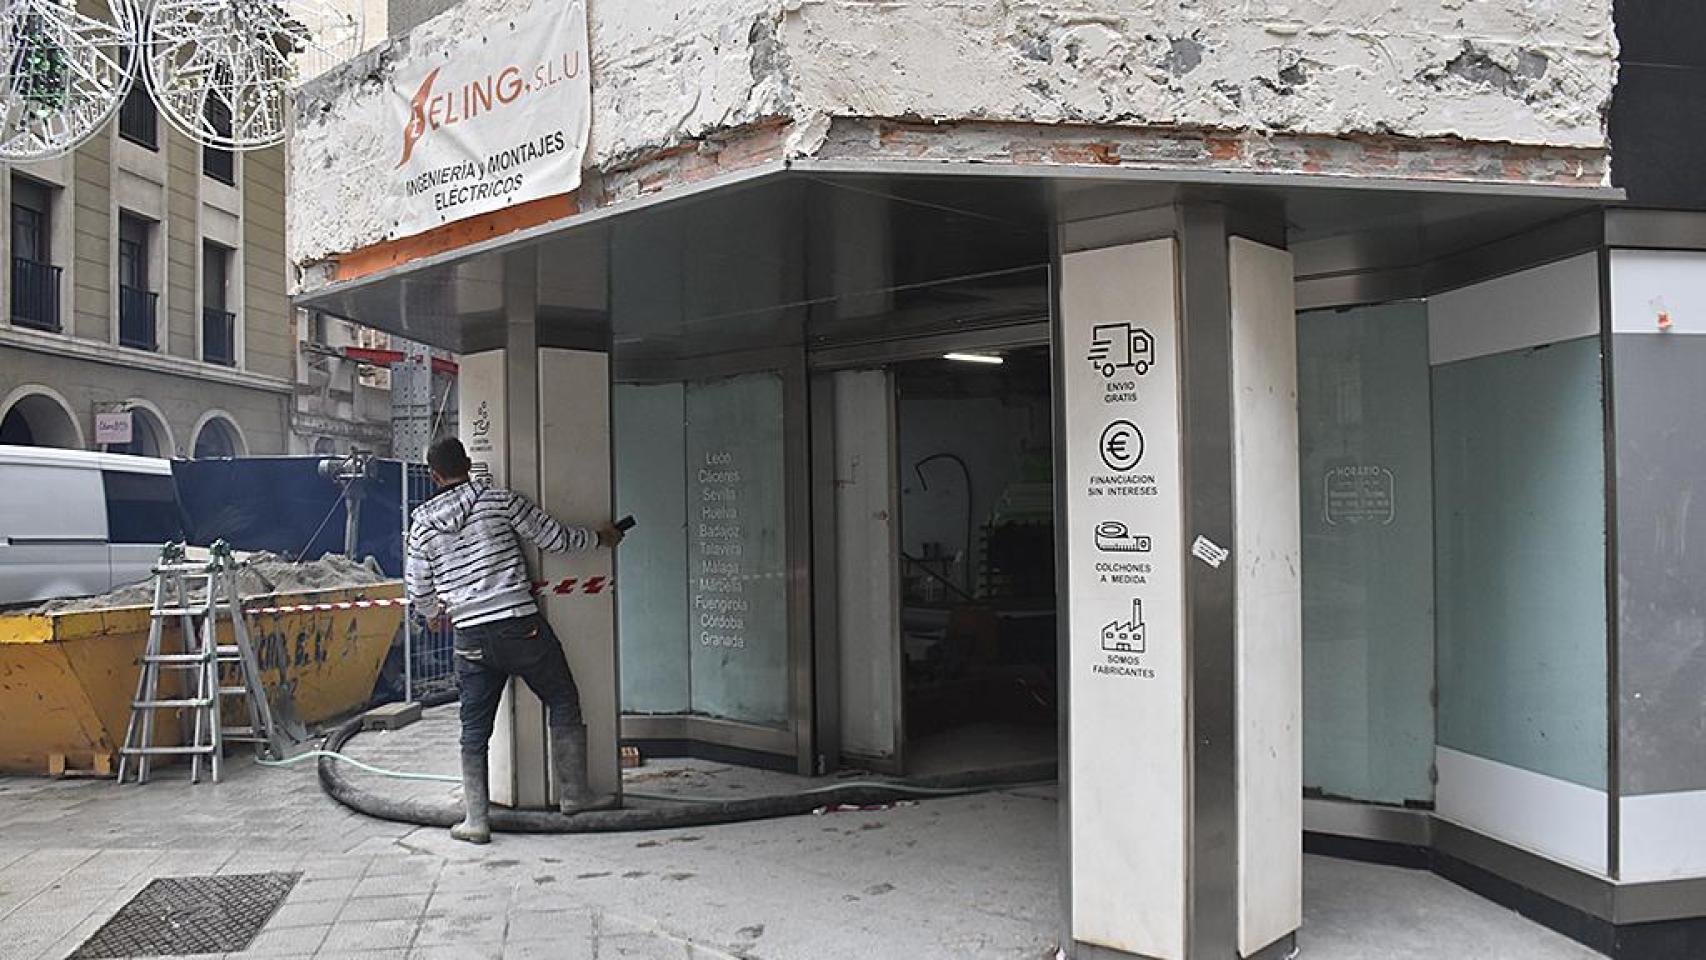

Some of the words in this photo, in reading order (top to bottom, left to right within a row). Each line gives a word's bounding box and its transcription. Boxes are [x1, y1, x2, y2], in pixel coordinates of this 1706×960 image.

[487, 131, 565, 175] MONTAJES
[434, 173, 524, 211] ELÉCTRICOS
[1104, 393, 1138, 403] GRATIS
[1088, 487, 1103, 497] SIN
[1107, 486, 1159, 496] INTERESES
[1095, 563, 1152, 573] COLCHONES
[1100, 575, 1108, 584] A
[1111, 574, 1147, 584] MEDIDA
[701, 631, 745, 648] Granada
[1107, 654, 1141, 666] SOMOS
[1092, 664, 1156, 679] FABRICANTES
